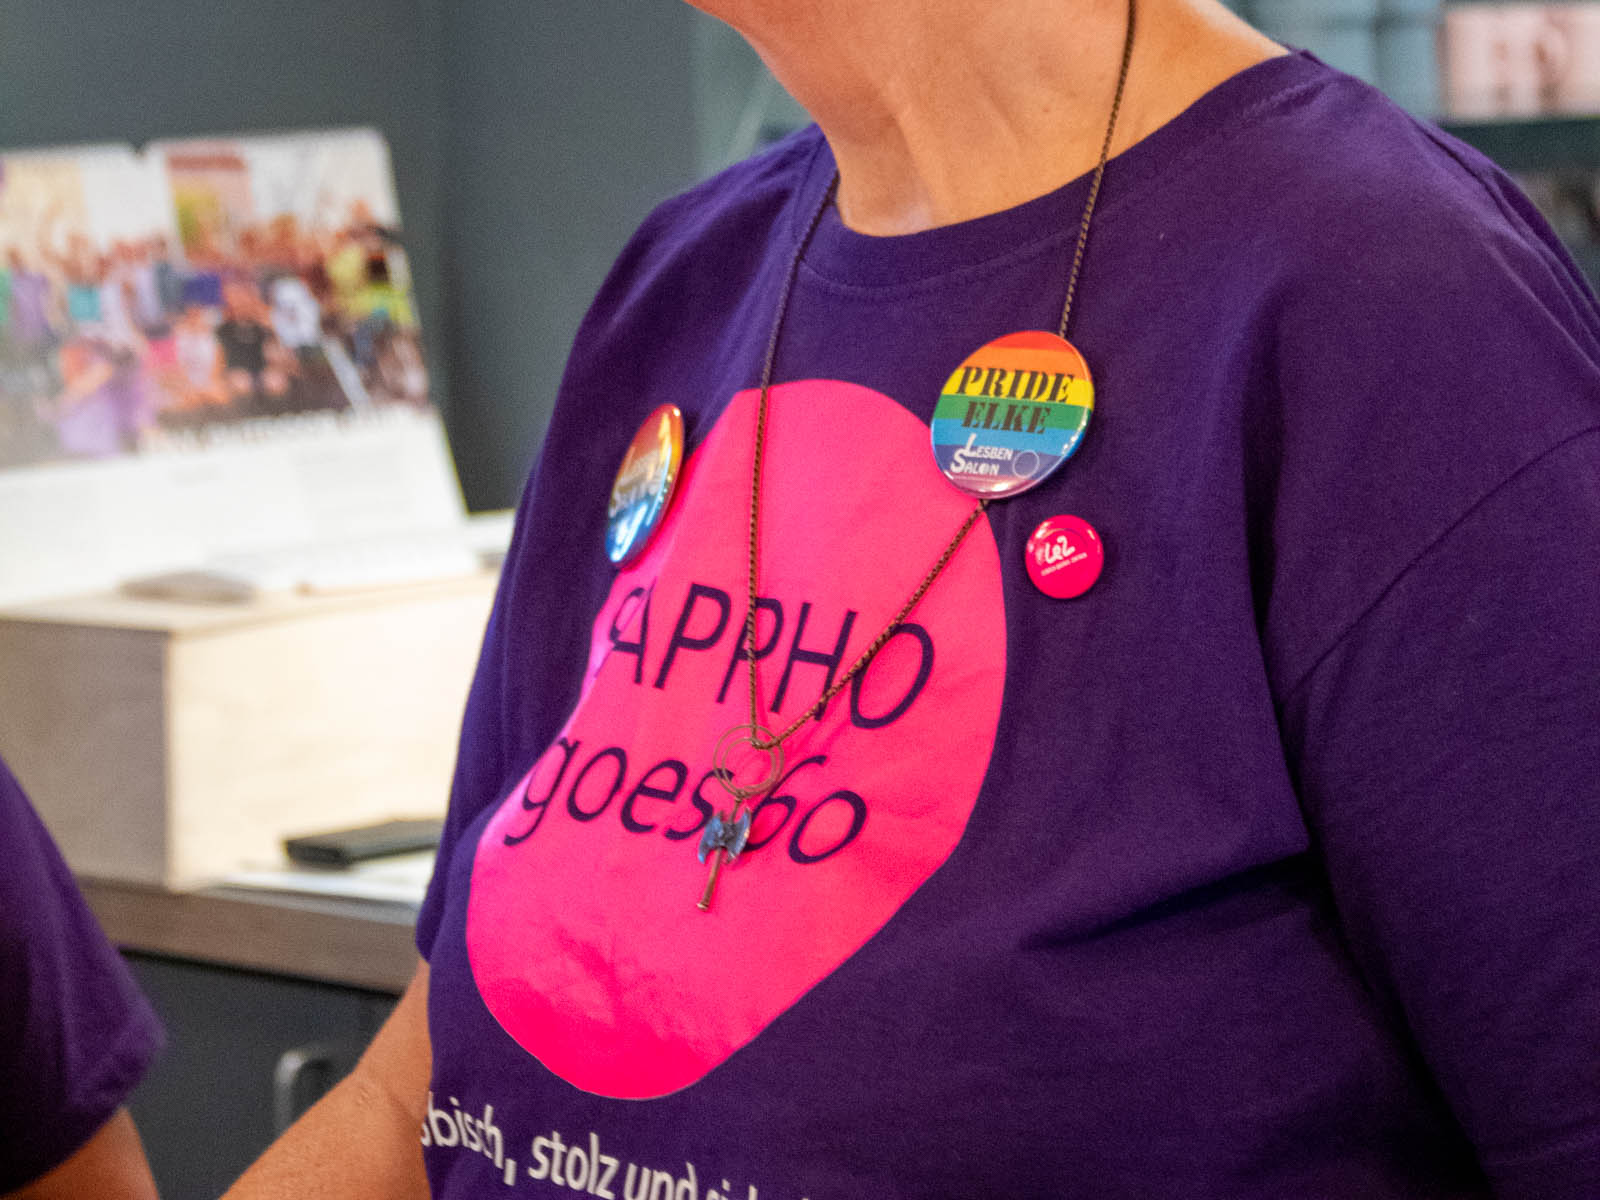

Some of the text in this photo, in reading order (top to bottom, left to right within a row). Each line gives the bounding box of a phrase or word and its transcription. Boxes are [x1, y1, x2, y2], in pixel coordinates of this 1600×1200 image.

[956, 366, 1074, 403] PRIDE
[962, 401, 1051, 434] ELKE
[503, 737, 735, 847] goes
[528, 1131, 619, 1200] stolz
